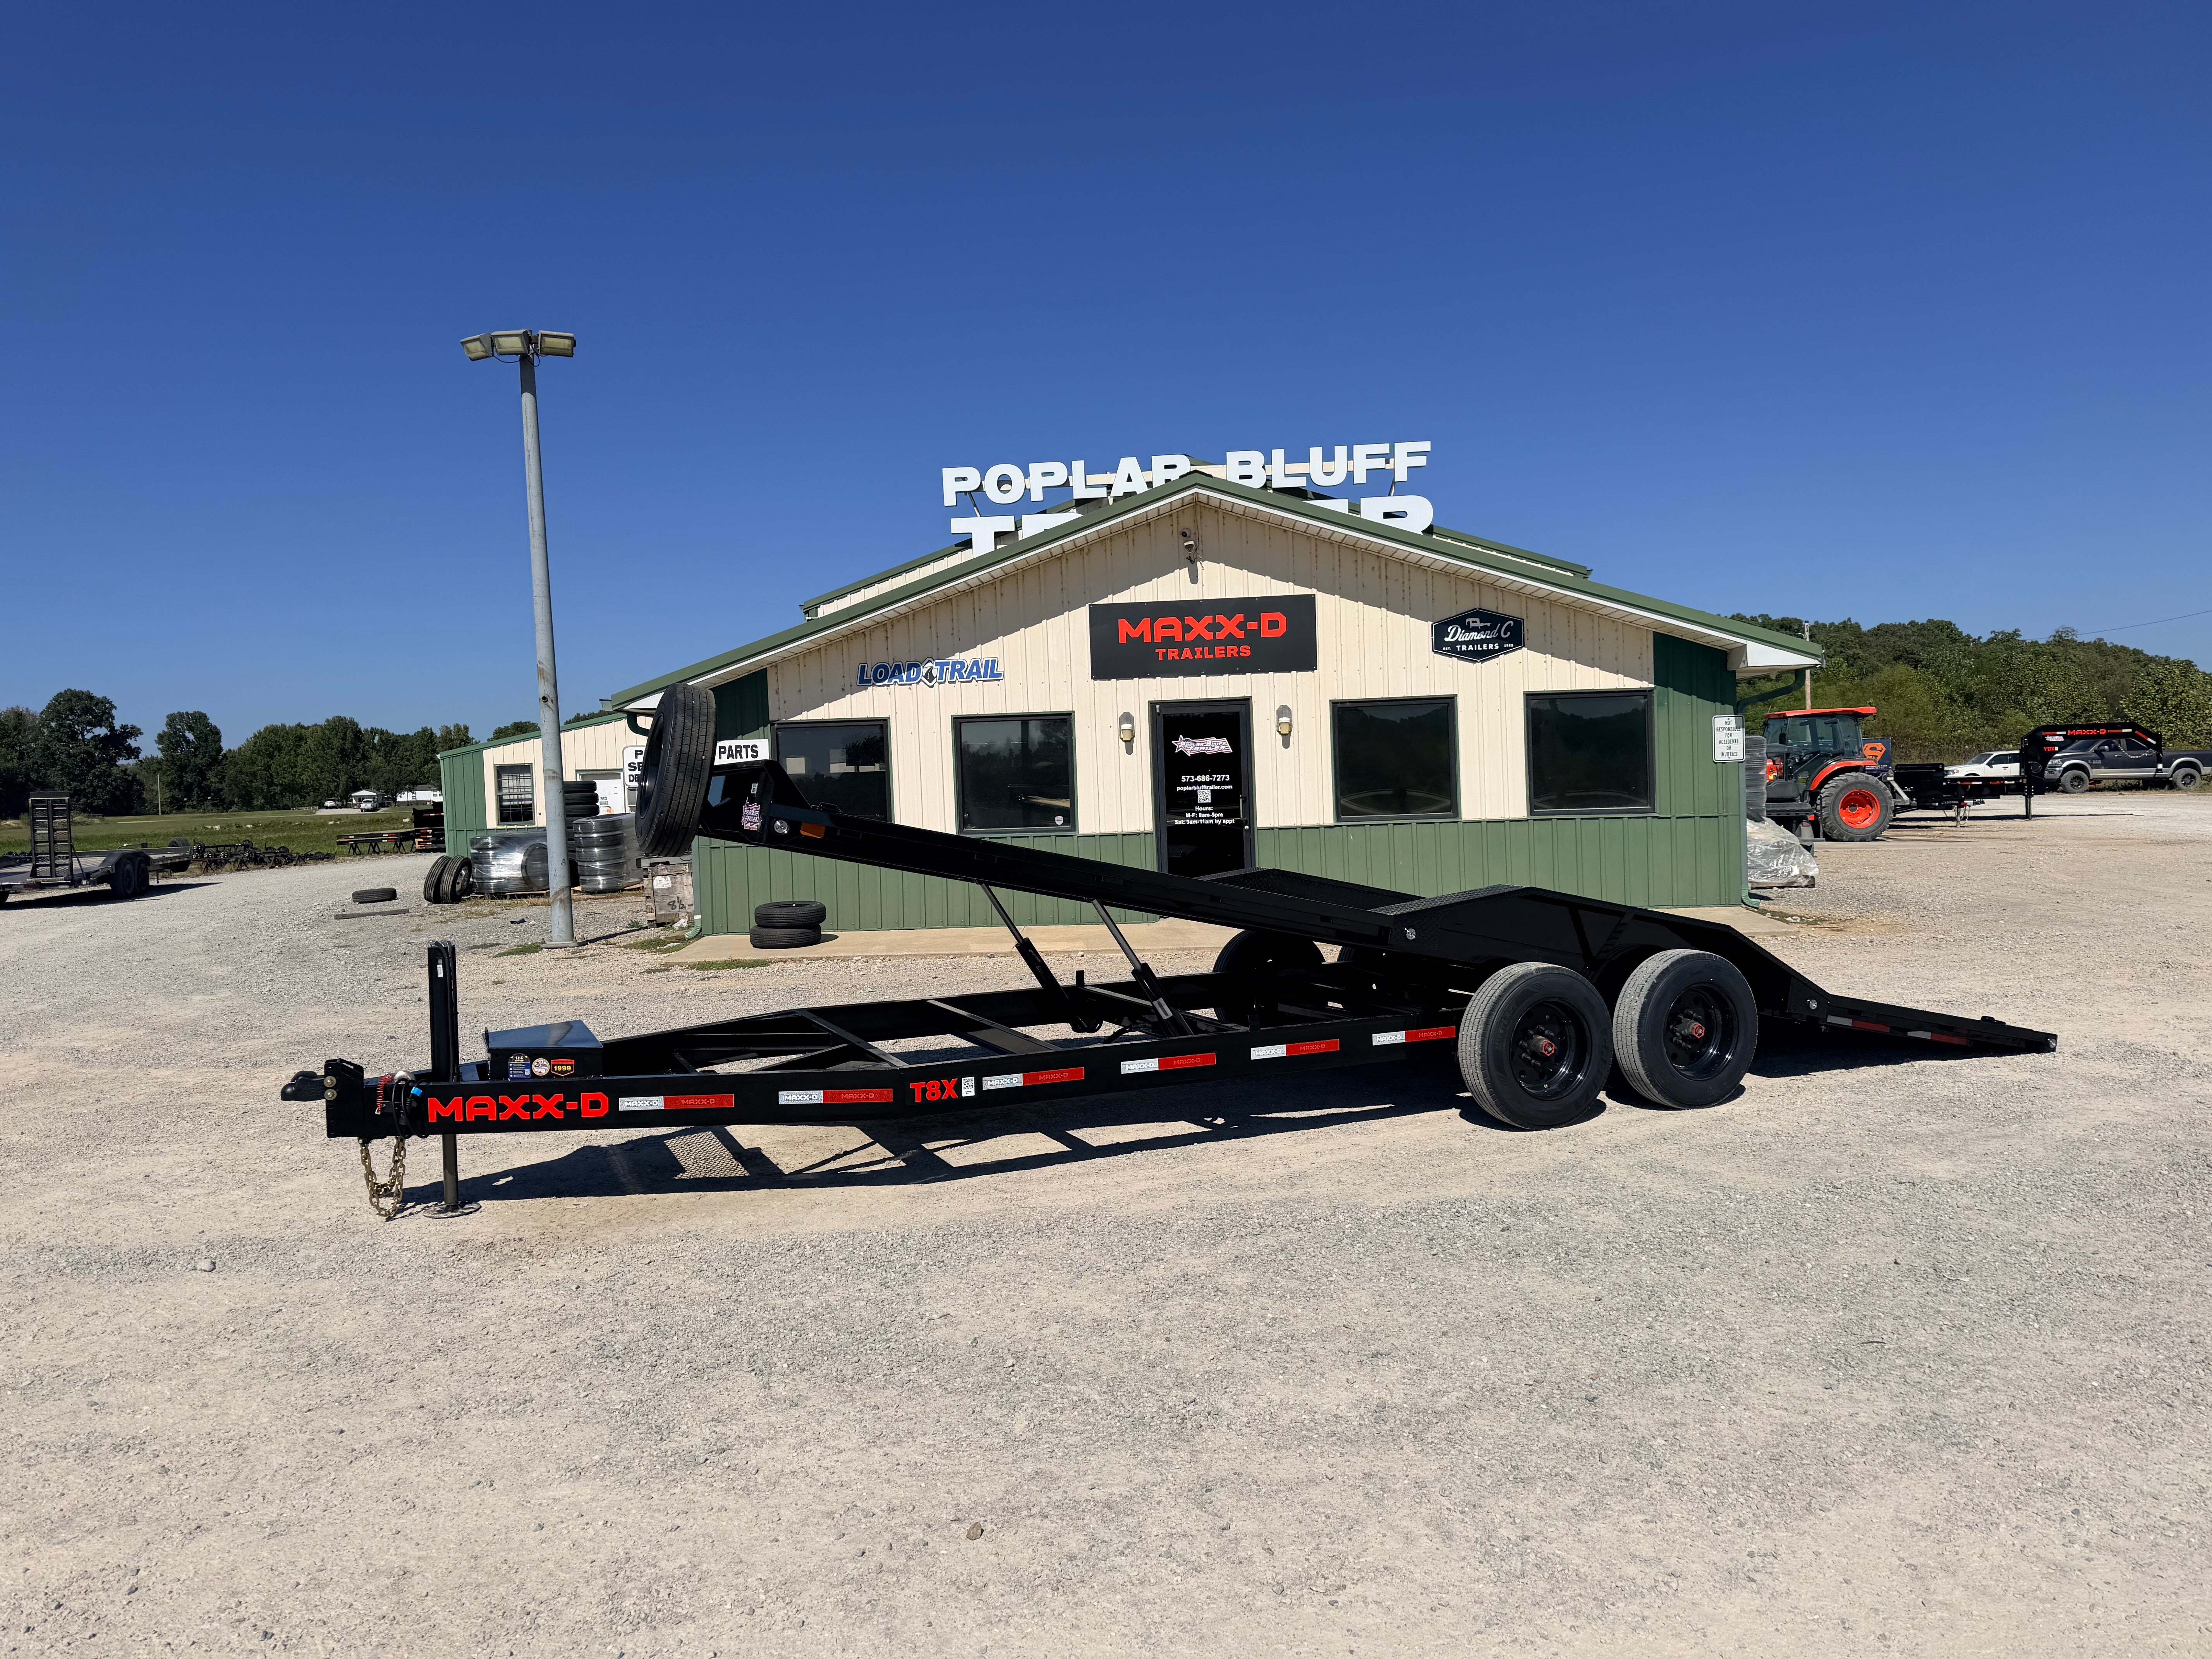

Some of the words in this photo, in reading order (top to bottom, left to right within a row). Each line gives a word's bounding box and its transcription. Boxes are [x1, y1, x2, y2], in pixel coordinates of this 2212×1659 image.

[942, 453, 1191, 507] POPLAR
[1226, 441, 1431, 489] BLUFF
[1118, 612, 1287, 644] MAXX-D
[1444, 623, 1501, 642] Diamond
[1501, 621, 1514, 638] C
[1156, 645, 1251, 660] TRAILERS
[857, 661, 923, 686] LOAD
[933, 657, 1004, 683] TRAIL
[719, 744, 759, 759] PARTS
[910, 1078, 958, 1102] T8X
[428, 1092, 609, 1122] MAXX-D
